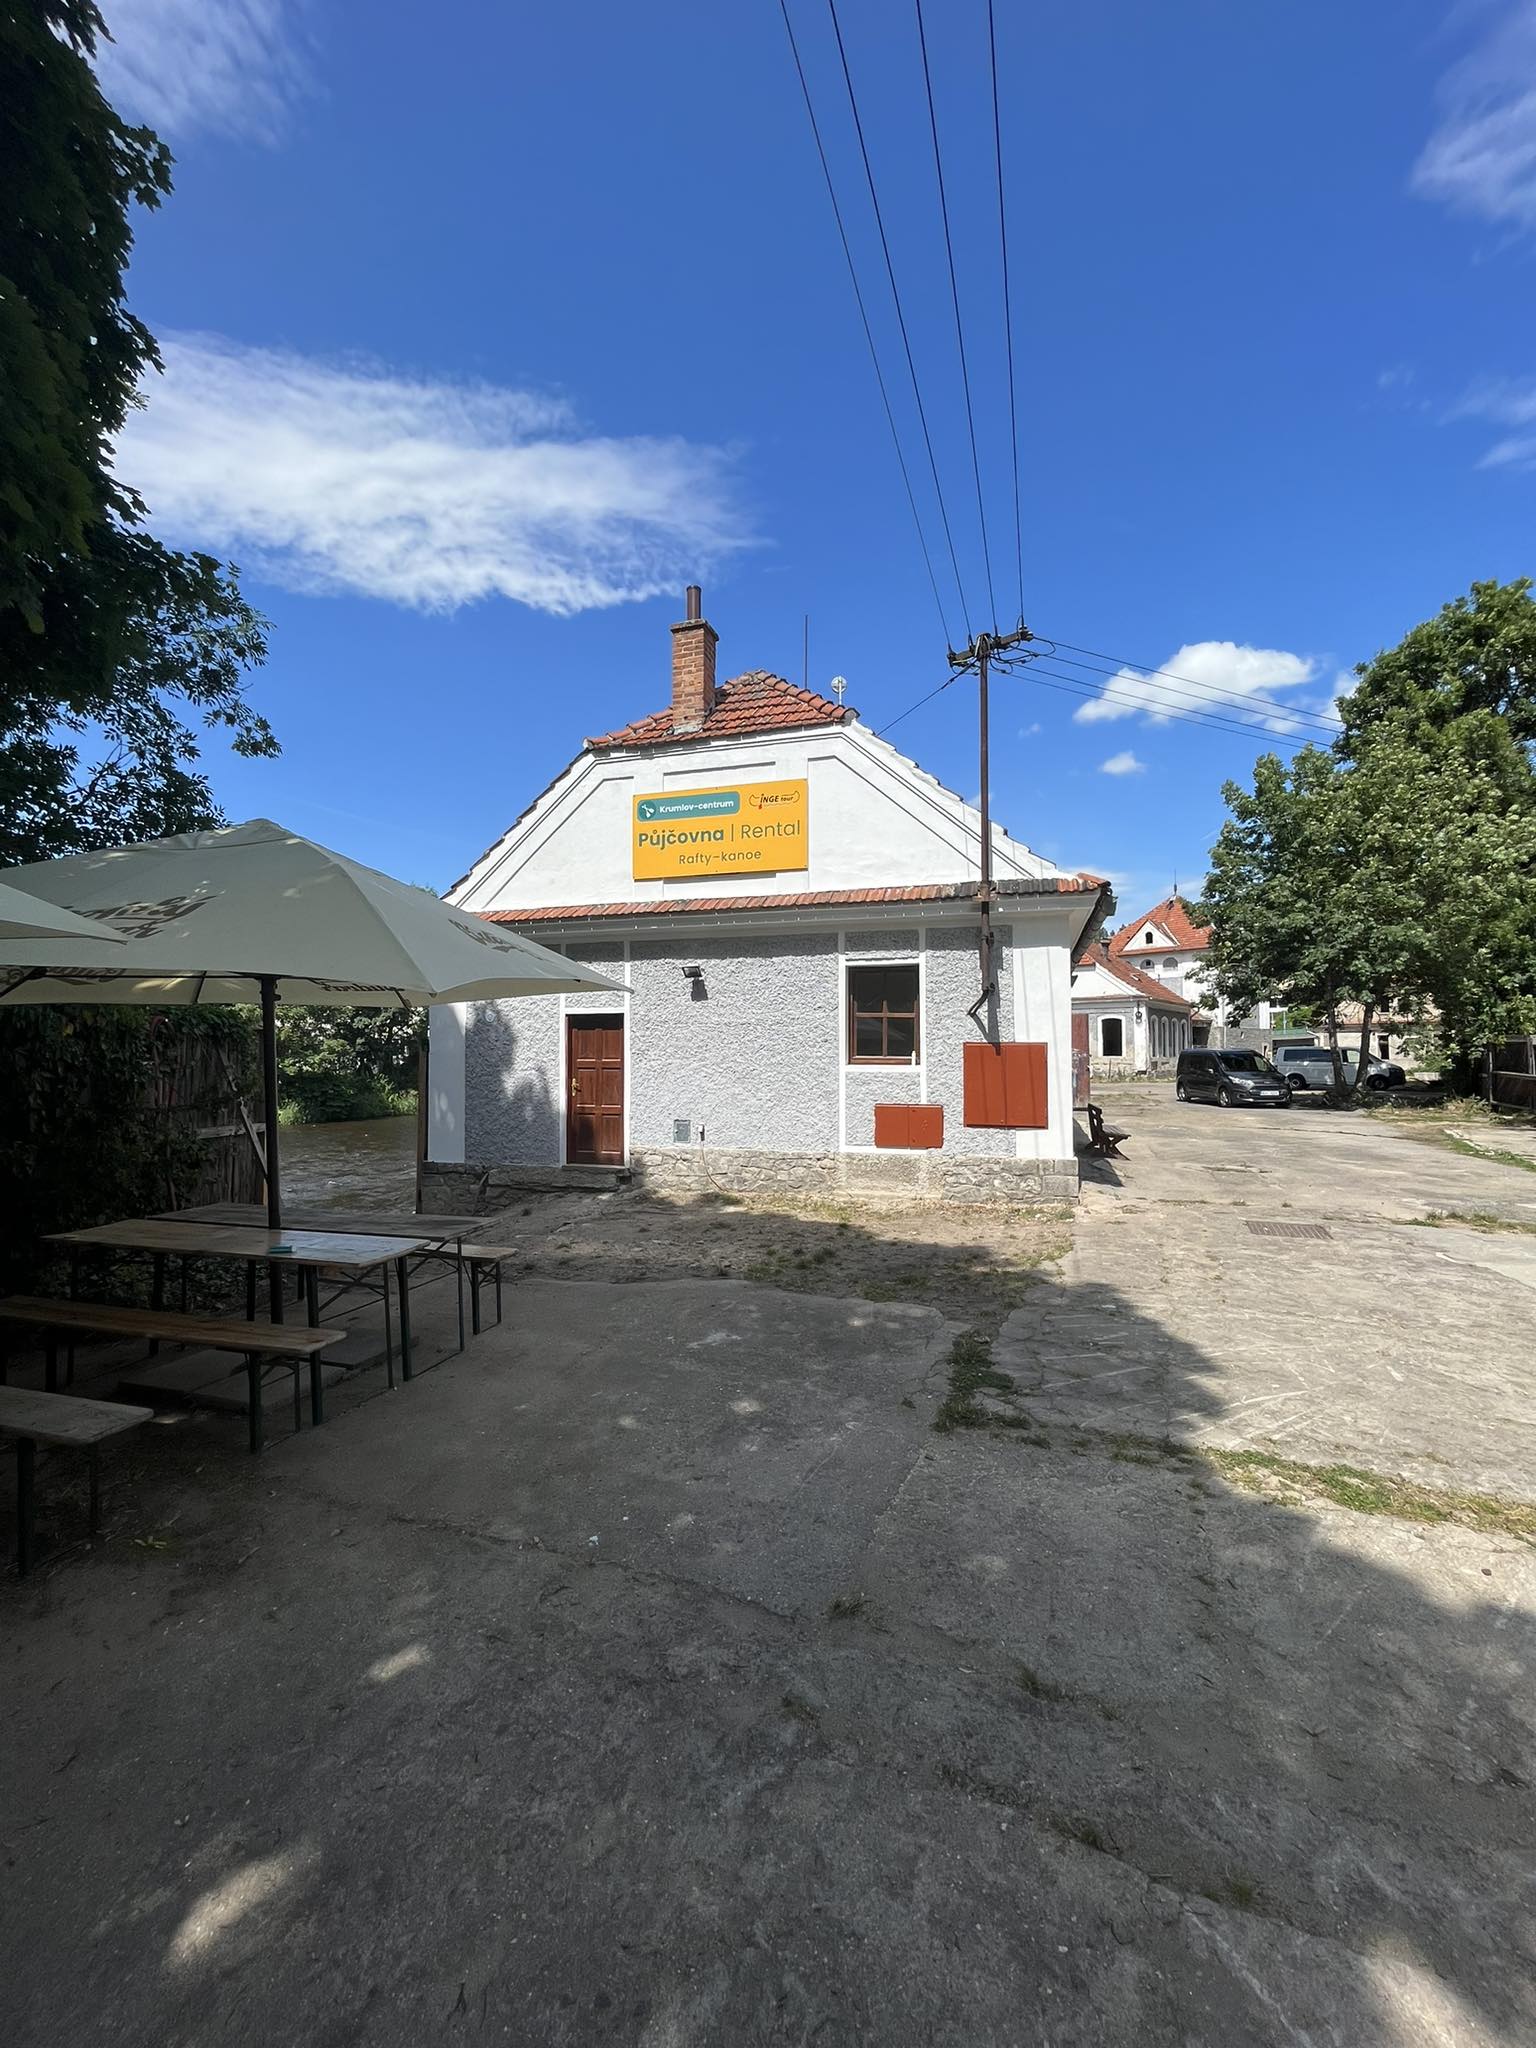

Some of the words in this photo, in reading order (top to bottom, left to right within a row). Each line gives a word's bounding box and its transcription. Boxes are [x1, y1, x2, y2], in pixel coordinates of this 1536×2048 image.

[659, 800, 735, 813] Krumlov-centrum
[638, 829, 724, 850] Půjčovna
[741, 819, 800, 839] Rental
